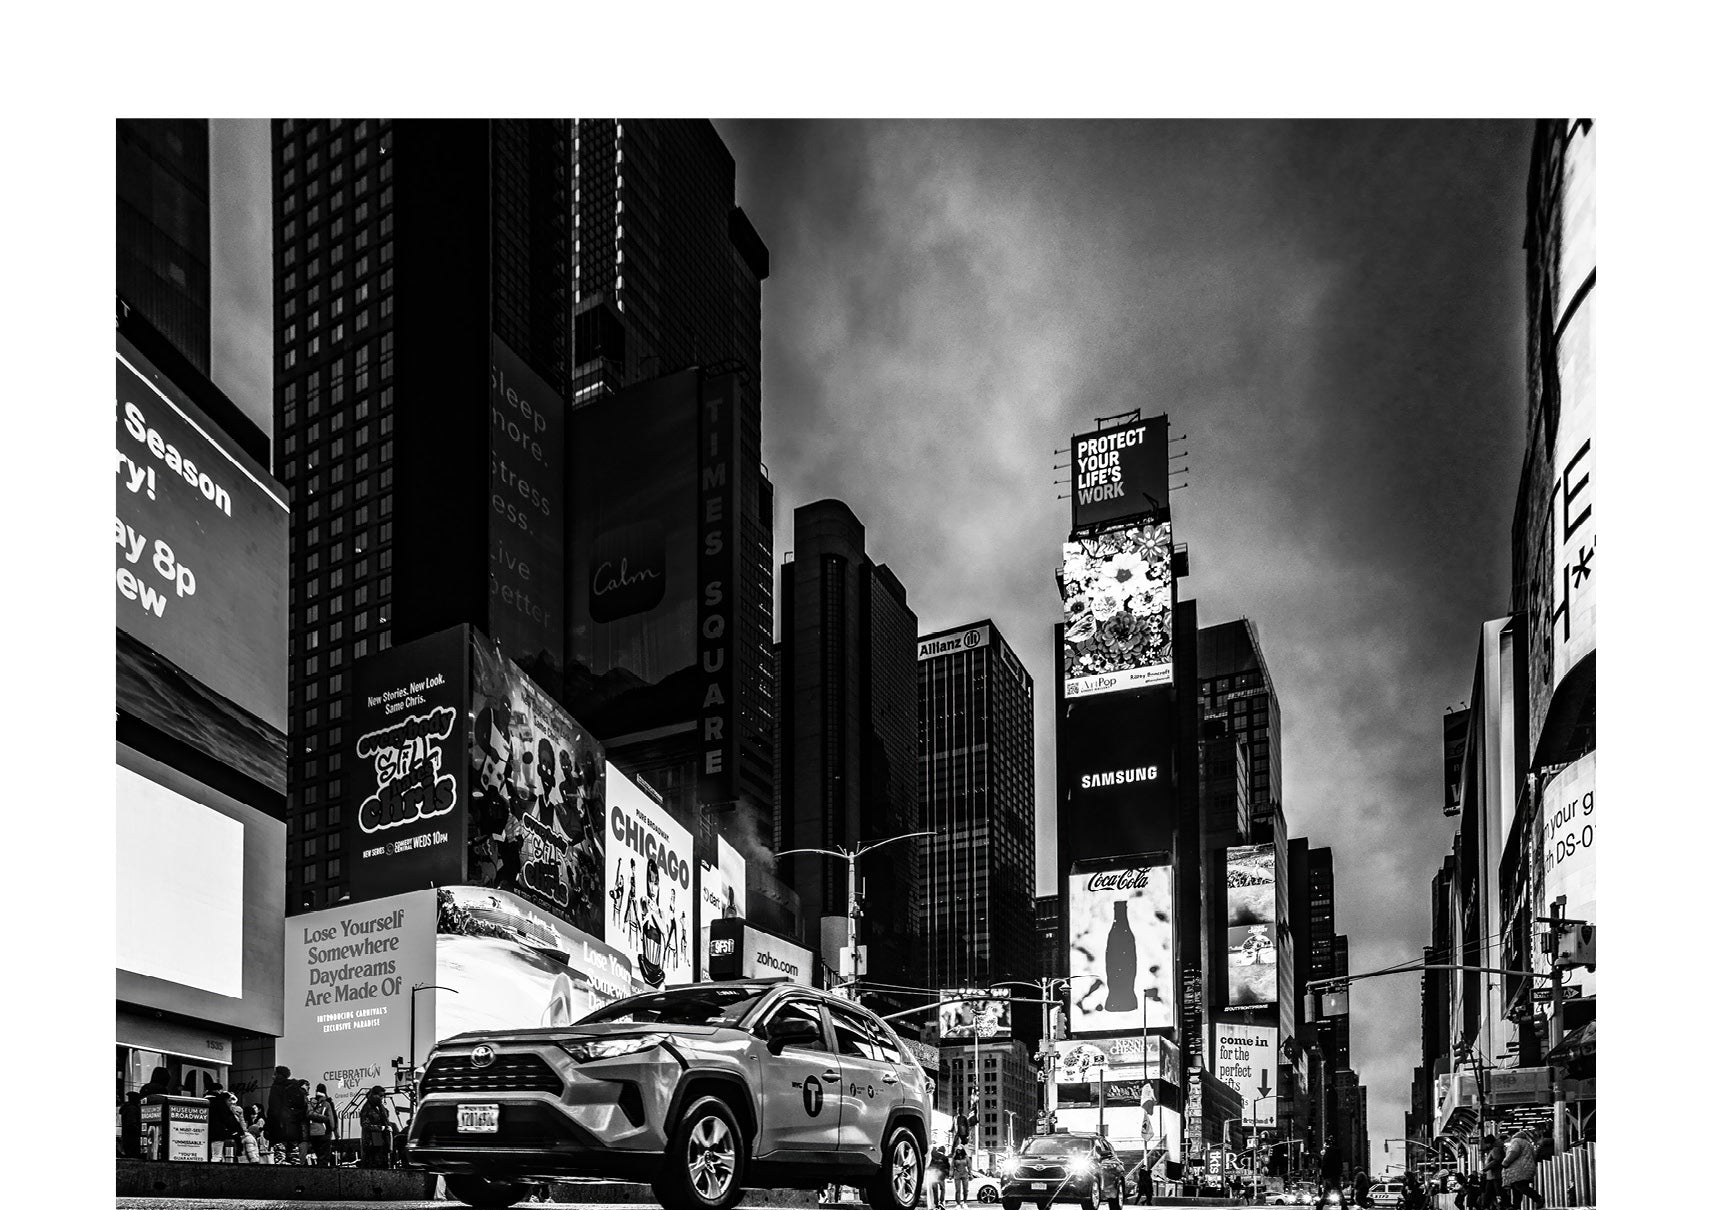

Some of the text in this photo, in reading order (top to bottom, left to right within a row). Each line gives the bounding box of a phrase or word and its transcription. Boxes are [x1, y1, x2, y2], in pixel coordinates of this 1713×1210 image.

[1078, 427, 1146, 458] PROTECT
[124, 402, 231, 517] Season
[1078, 450, 1120, 473] YOUR
[1078, 466, 1121, 489] LIFE'S
[1078, 481, 1125, 506] WORK
[153, 539, 196, 598] 8p
[593, 557, 662, 598] Calm
[702, 396, 726, 776] TIMES SQUARE
[920, 638, 962, 657] Allianz
[367, 674, 445, 708] New Stories. New Look.
[385, 695, 426, 715] Same Chris.
[1081, 766, 1158, 788] SAMSUNG
[1550, 799, 1578, 840] your
[413, 833, 432, 849] WEDS
[611, 805, 690, 890] CHICAGO
[1088, 867, 1152, 892] Coca-Cola
[304, 908, 405, 945] Lose Yourself
[308, 936, 400, 965] Somewhere
[310, 960, 396, 988] Daydreams
[757, 951, 799, 977] zoho.com
[305, 976, 403, 1007] Are Made Of
[316, 1011, 354, 1023] INTRODUCING
[323, 1018, 380, 1033] EXCLUSIVE PARADISE
[1220, 1036, 1268, 1047] come in
[1220, 1045, 1250, 1061] for the
[323, 1065, 381, 1081] CELEBRATION
[1220, 1064, 1252, 1080] perfect
[343, 1079, 360, 1090] KEY
[1224, 1078, 1241, 1091] ifts
[1209, 1150, 1221, 1174] tkts
